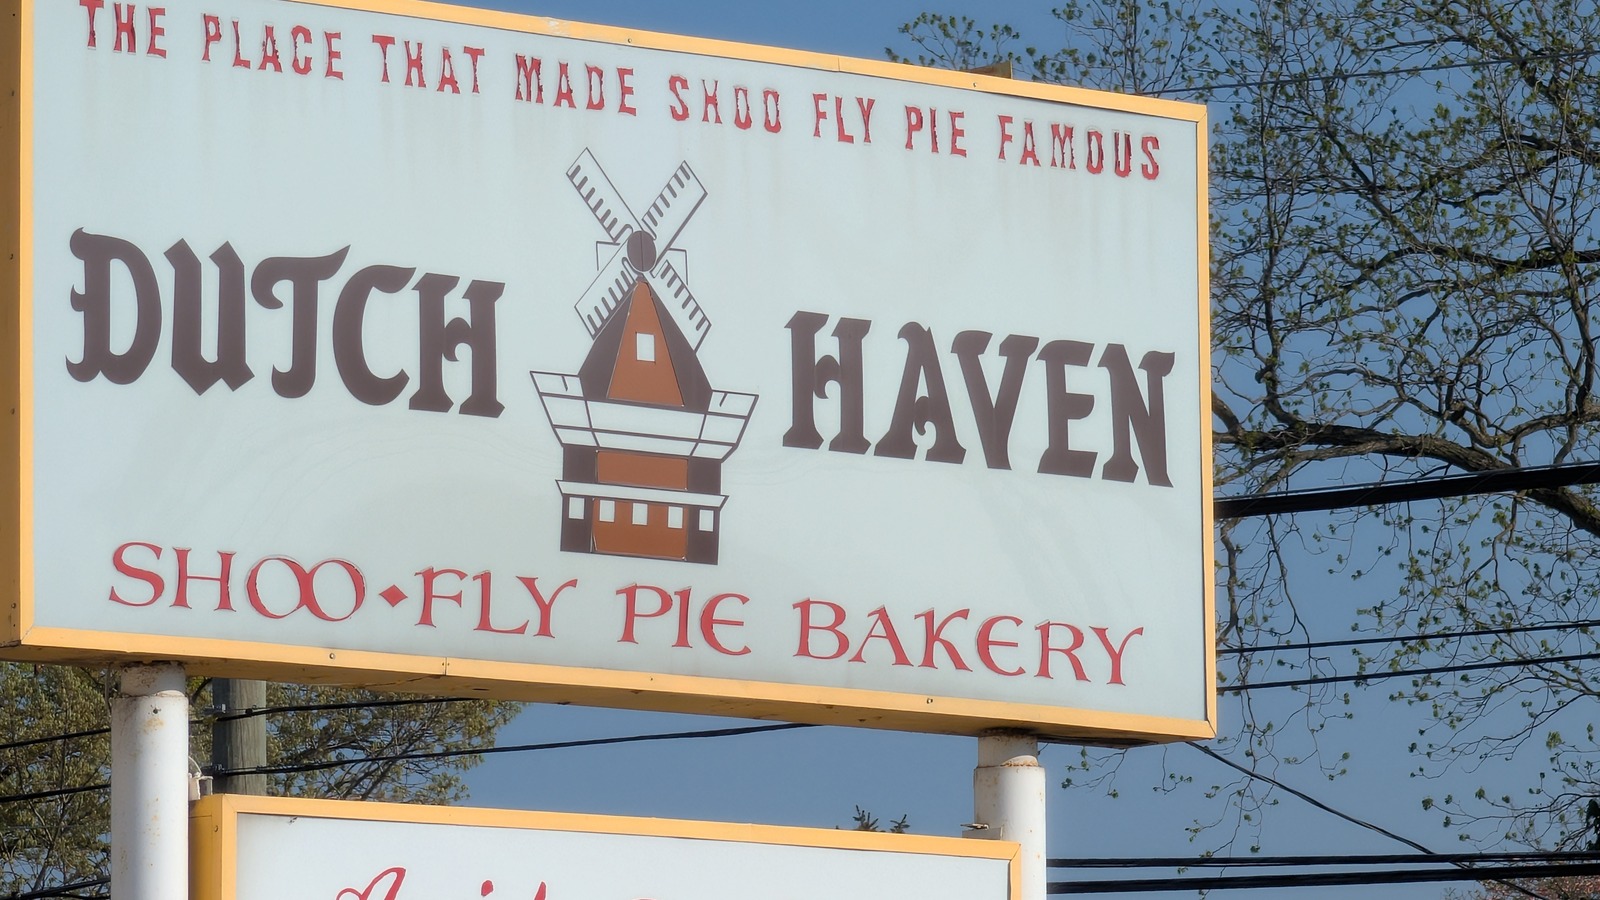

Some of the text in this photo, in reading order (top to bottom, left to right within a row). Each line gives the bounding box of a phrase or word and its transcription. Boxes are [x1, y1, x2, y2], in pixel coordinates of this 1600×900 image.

[79, 0, 1161, 181] THE PLACE THAT MADE SHOO FLY PIE FAMOUS
[66, 226, 1176, 488] DUTCH HAVEN
[616, 584, 750, 656] PIE
[793, 599, 1144, 686] BAKERY
